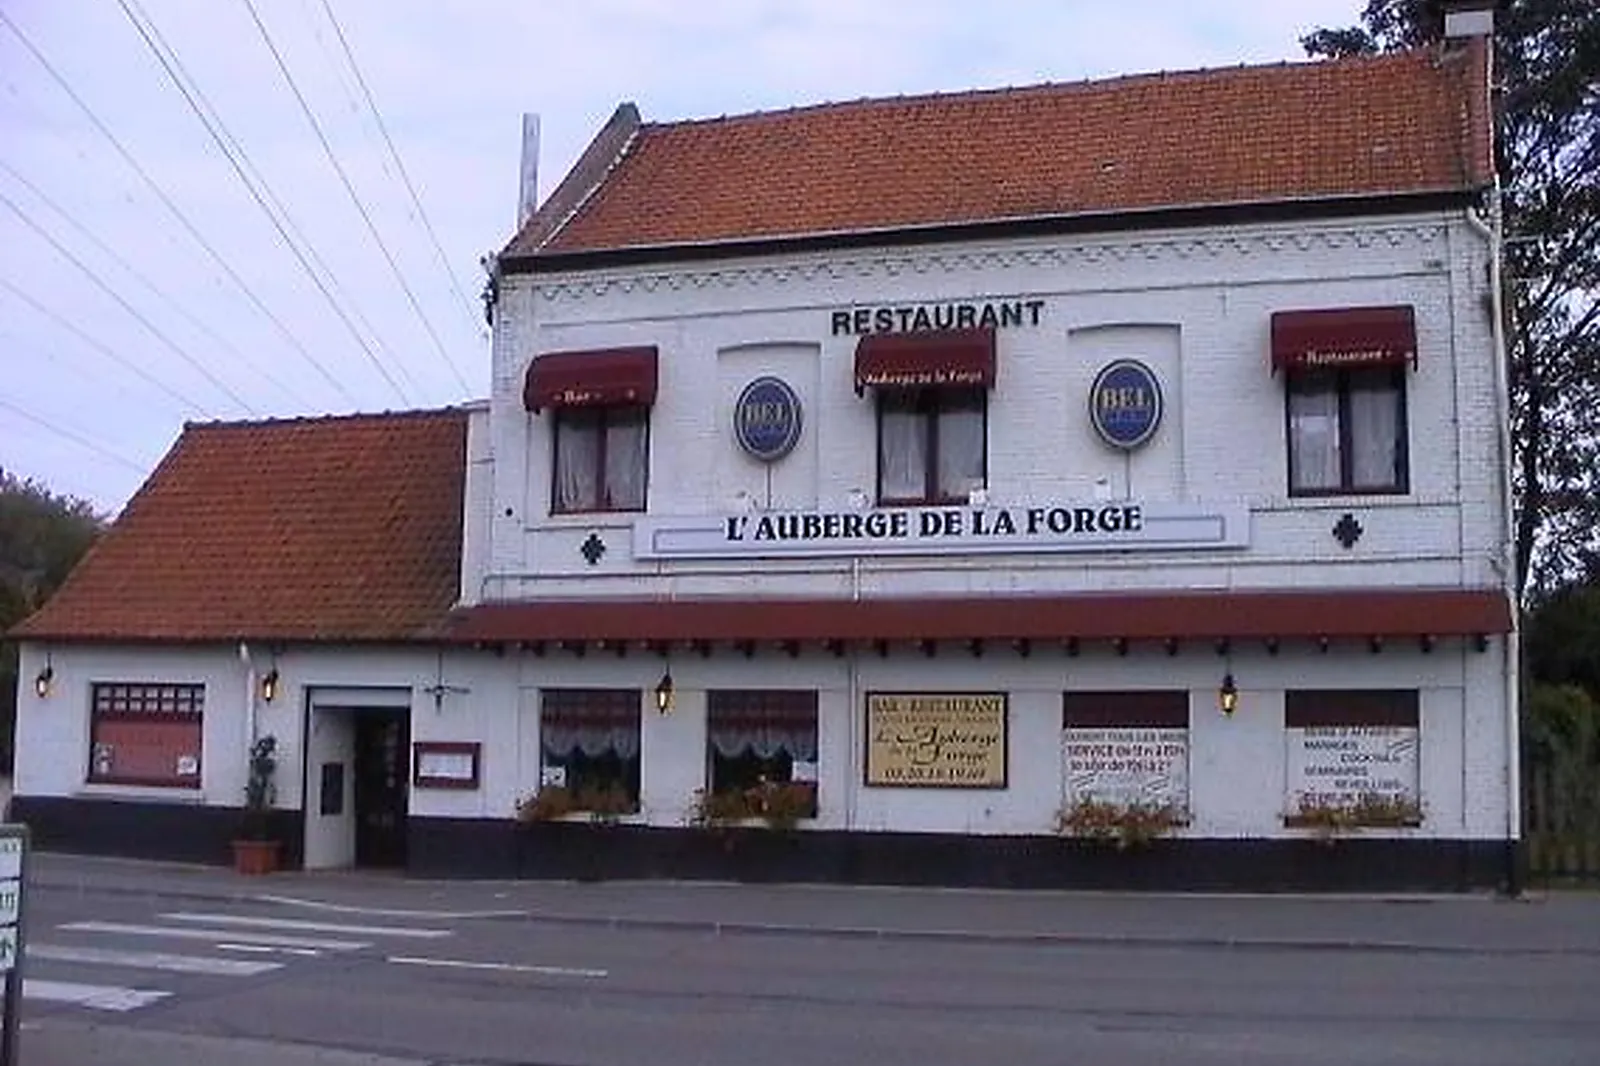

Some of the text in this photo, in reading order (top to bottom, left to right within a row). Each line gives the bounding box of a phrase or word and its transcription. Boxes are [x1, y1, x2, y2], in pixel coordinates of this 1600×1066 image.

[831, 301, 1045, 336] RESTAURANT
[755, 513, 908, 540] AUBERGE
[919, 511, 962, 537] DE
[972, 509, 1015, 535] LA
[1026, 506, 1142, 533] FORGE
